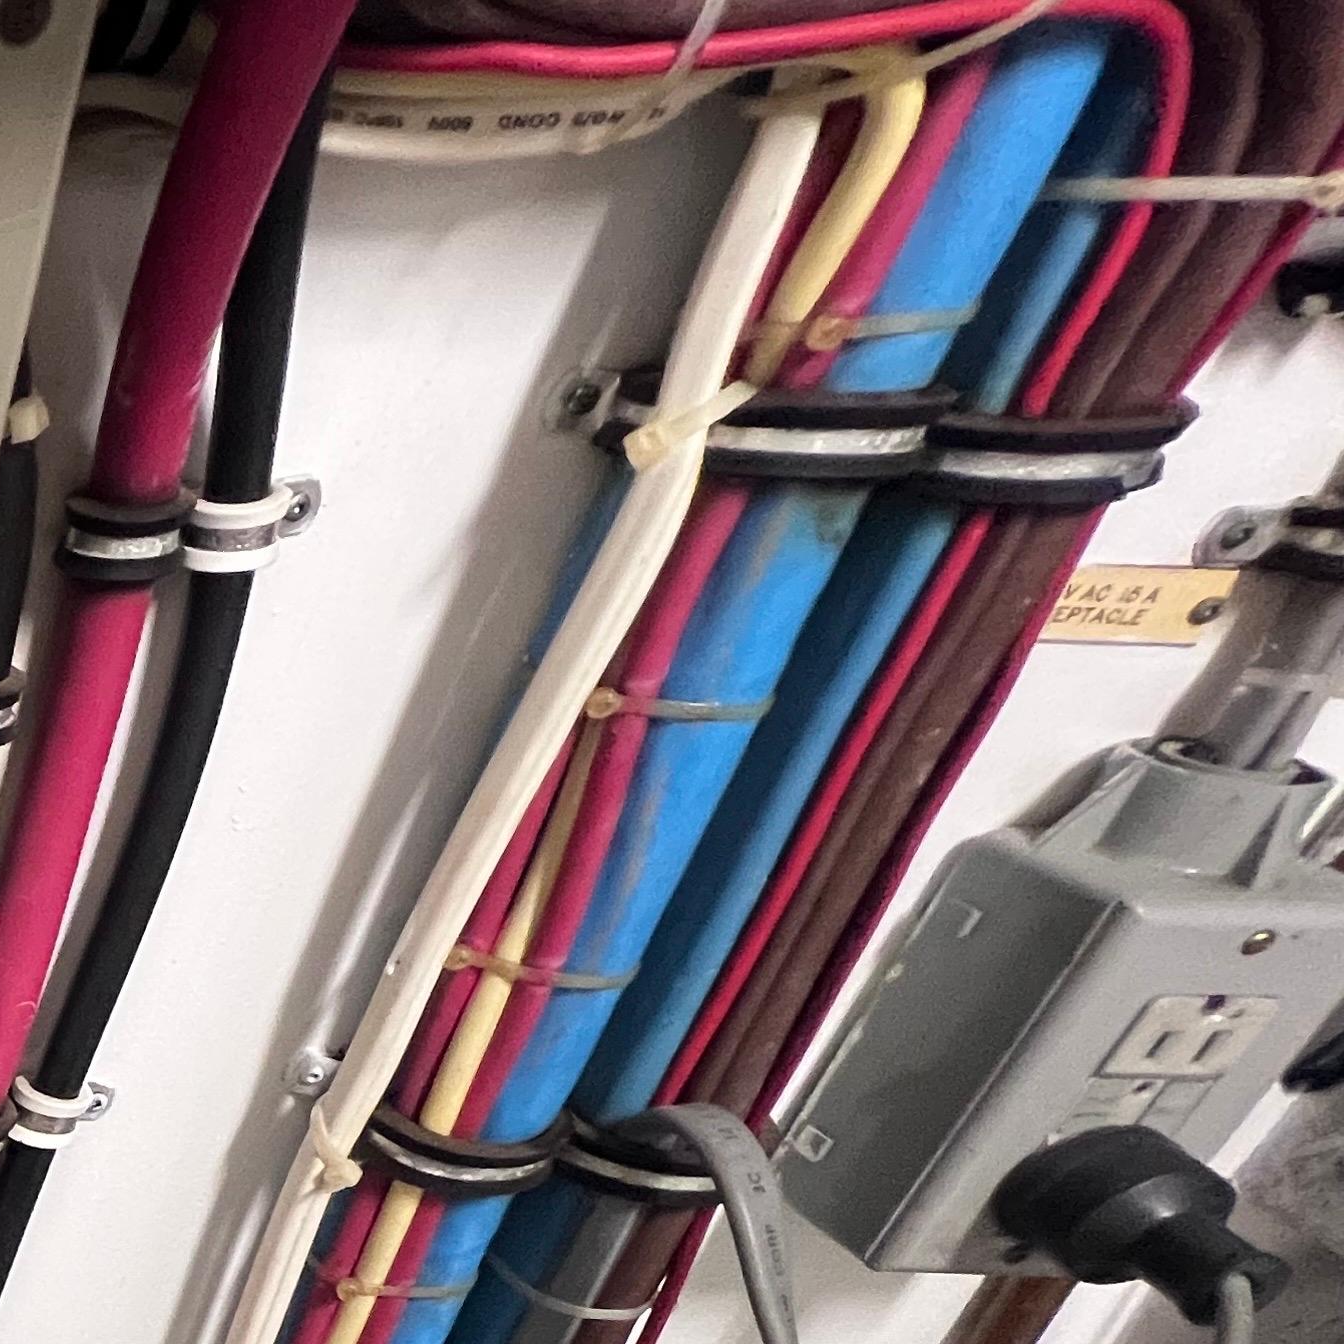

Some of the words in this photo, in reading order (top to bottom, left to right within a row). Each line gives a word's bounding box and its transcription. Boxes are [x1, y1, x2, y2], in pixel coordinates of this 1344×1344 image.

[1079, 583, 1113, 602] AC
[1145, 585, 1162, 604] A
[1052, 605, 1149, 626] EPTACLE
